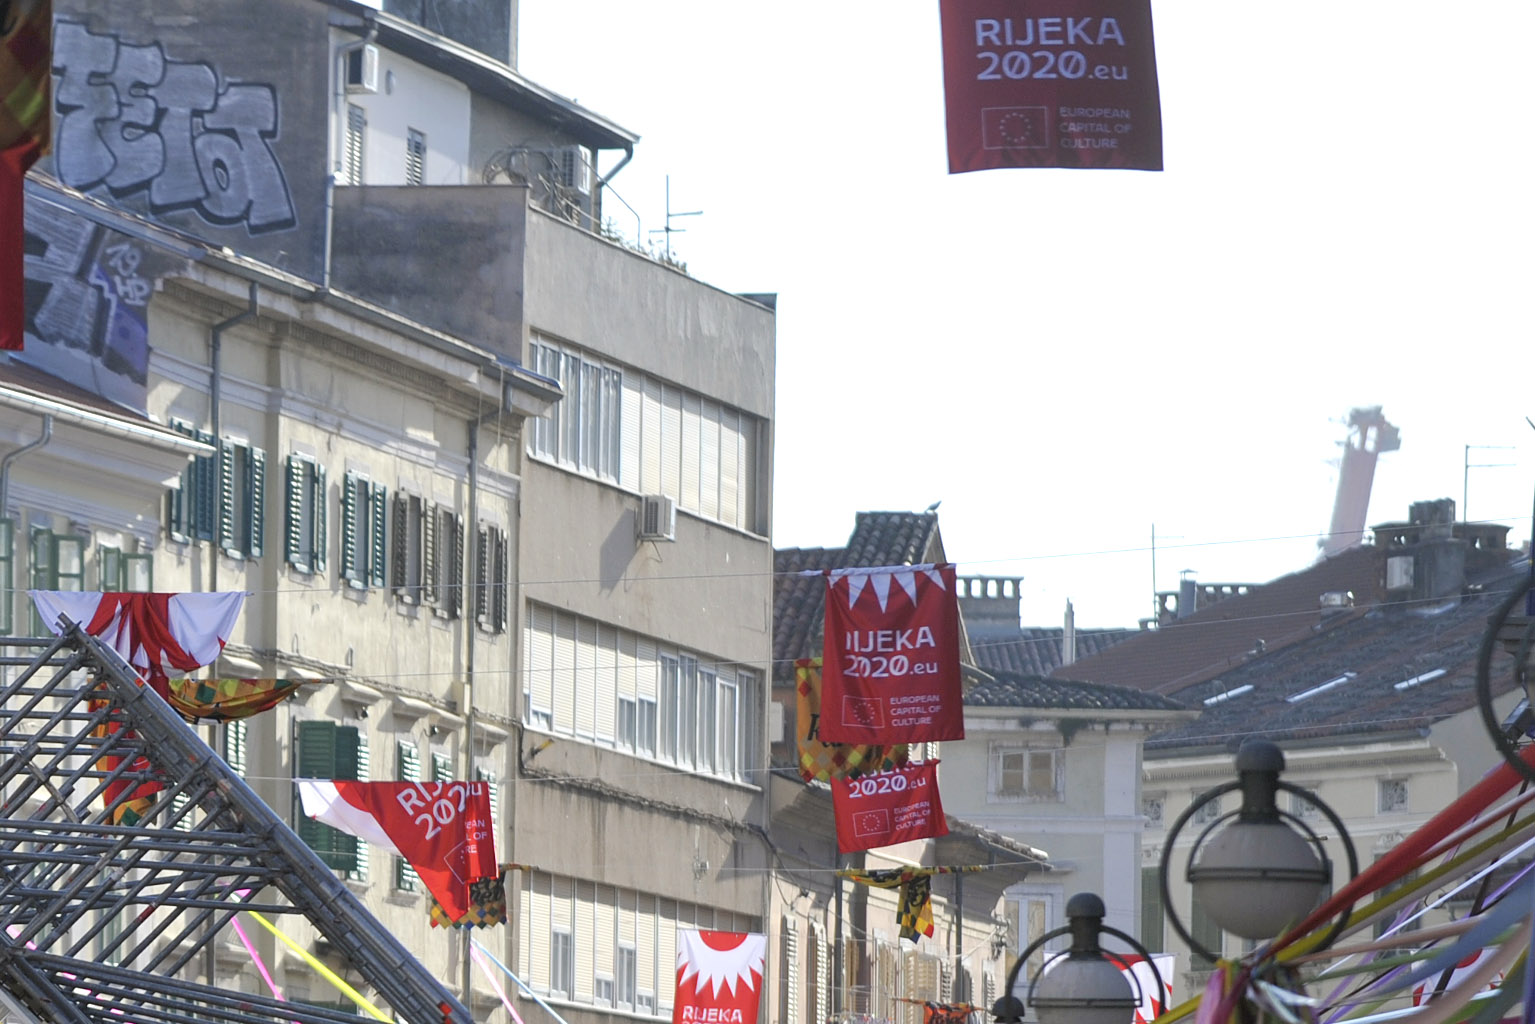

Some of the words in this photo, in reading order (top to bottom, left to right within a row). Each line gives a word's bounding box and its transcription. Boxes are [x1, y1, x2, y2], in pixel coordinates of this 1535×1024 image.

[975, 17, 1125, 46] RIJEKA
[977, 50, 1128, 80] 2020.eu
[1059, 106, 1131, 119] EUROPEAN
[1059, 122, 1111, 134] CAPITAL
[1114, 123, 1132, 134] OF
[1060, 137, 1119, 149] CULTURE
[890, 695, 940, 705] EUROPEAN
[890, 708, 927, 716] CAPITAL
[891, 717, 932, 726] CULTURE
[849, 775, 927, 799] 2020.eu
[683, 1005, 742, 1023] RIJEKA
